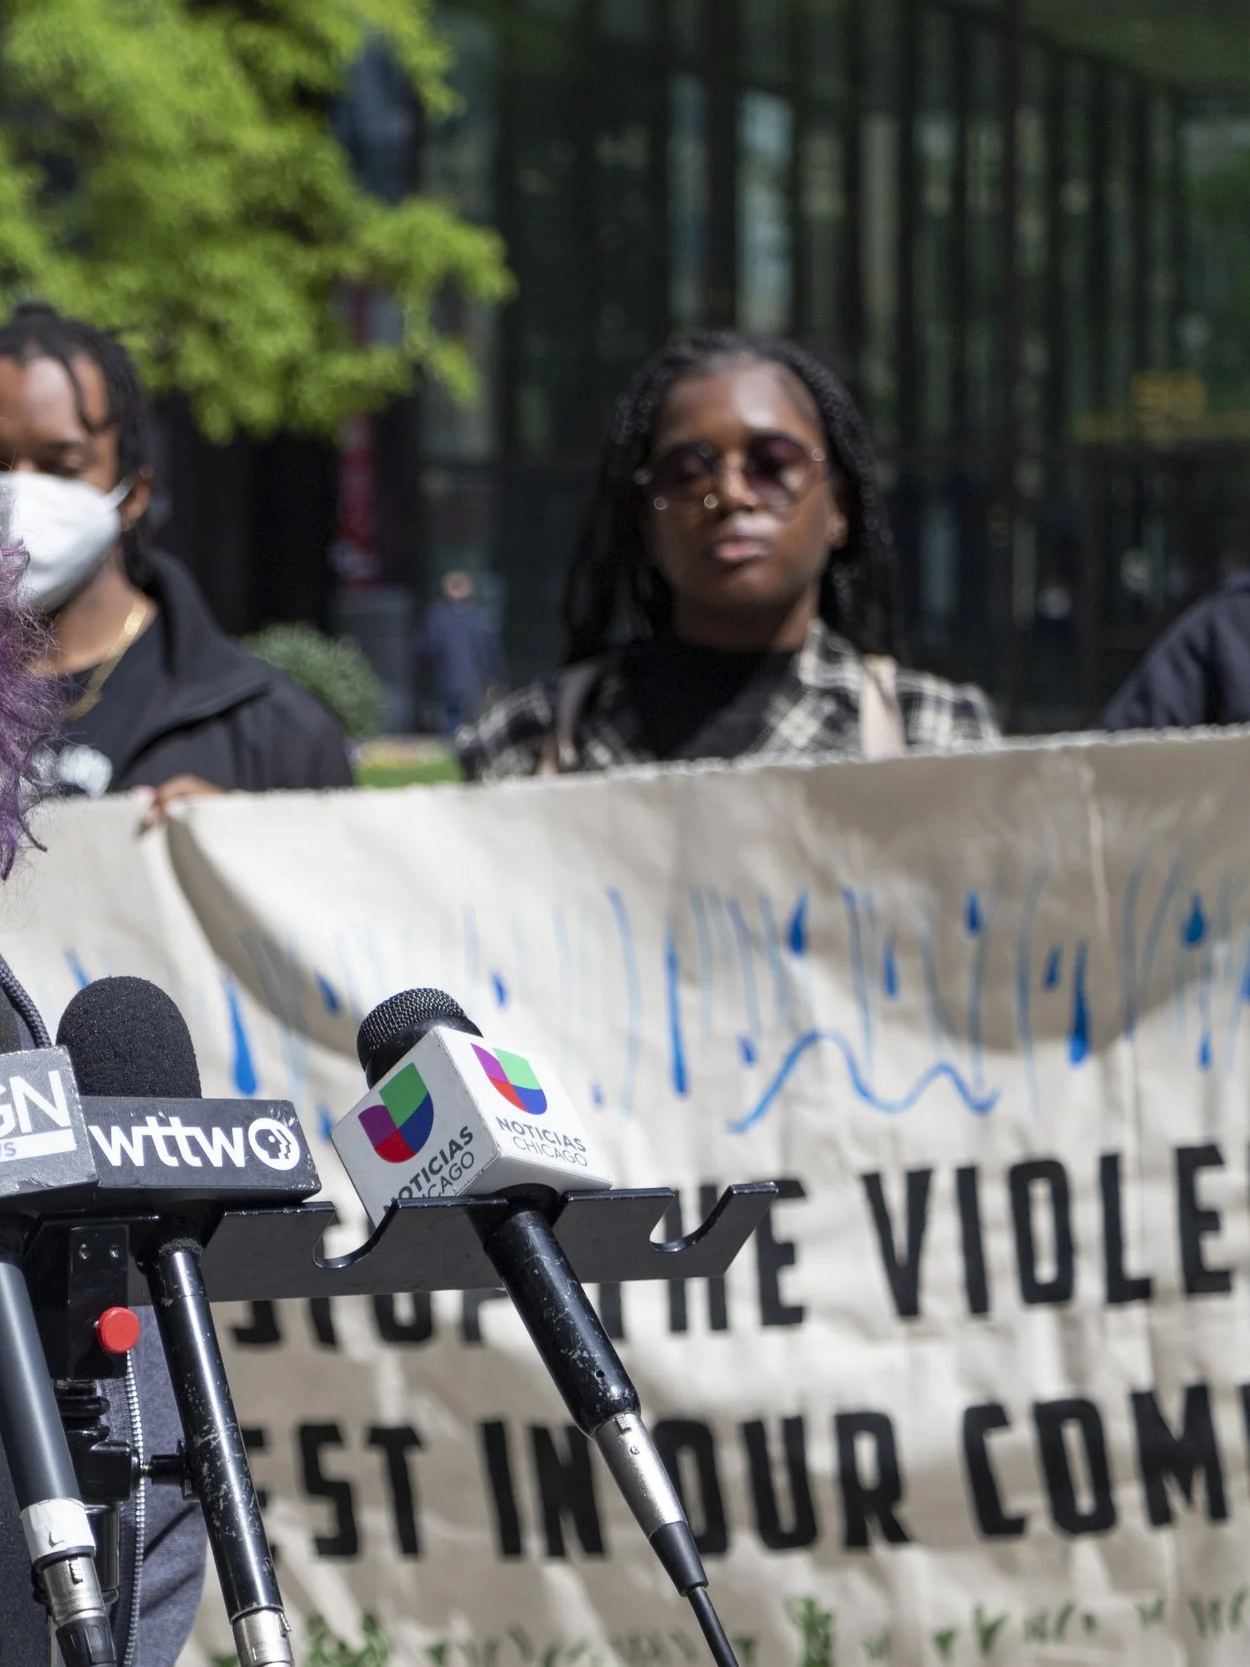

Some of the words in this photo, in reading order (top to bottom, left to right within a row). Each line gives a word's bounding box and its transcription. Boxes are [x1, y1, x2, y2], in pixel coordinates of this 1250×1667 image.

[89, 1116, 245, 1167] wttw
[495, 1116, 586, 1152] NOTICIAS
[513, 1136, 588, 1166] CHICAGO
[383, 1125, 474, 1213] OTICIAS
[861, 1143, 1250, 1317] VIOLE
[480, 1420, 606, 1558] IN
[654, 1412, 910, 1556] OUR
[961, 1383, 1250, 1540] COM
